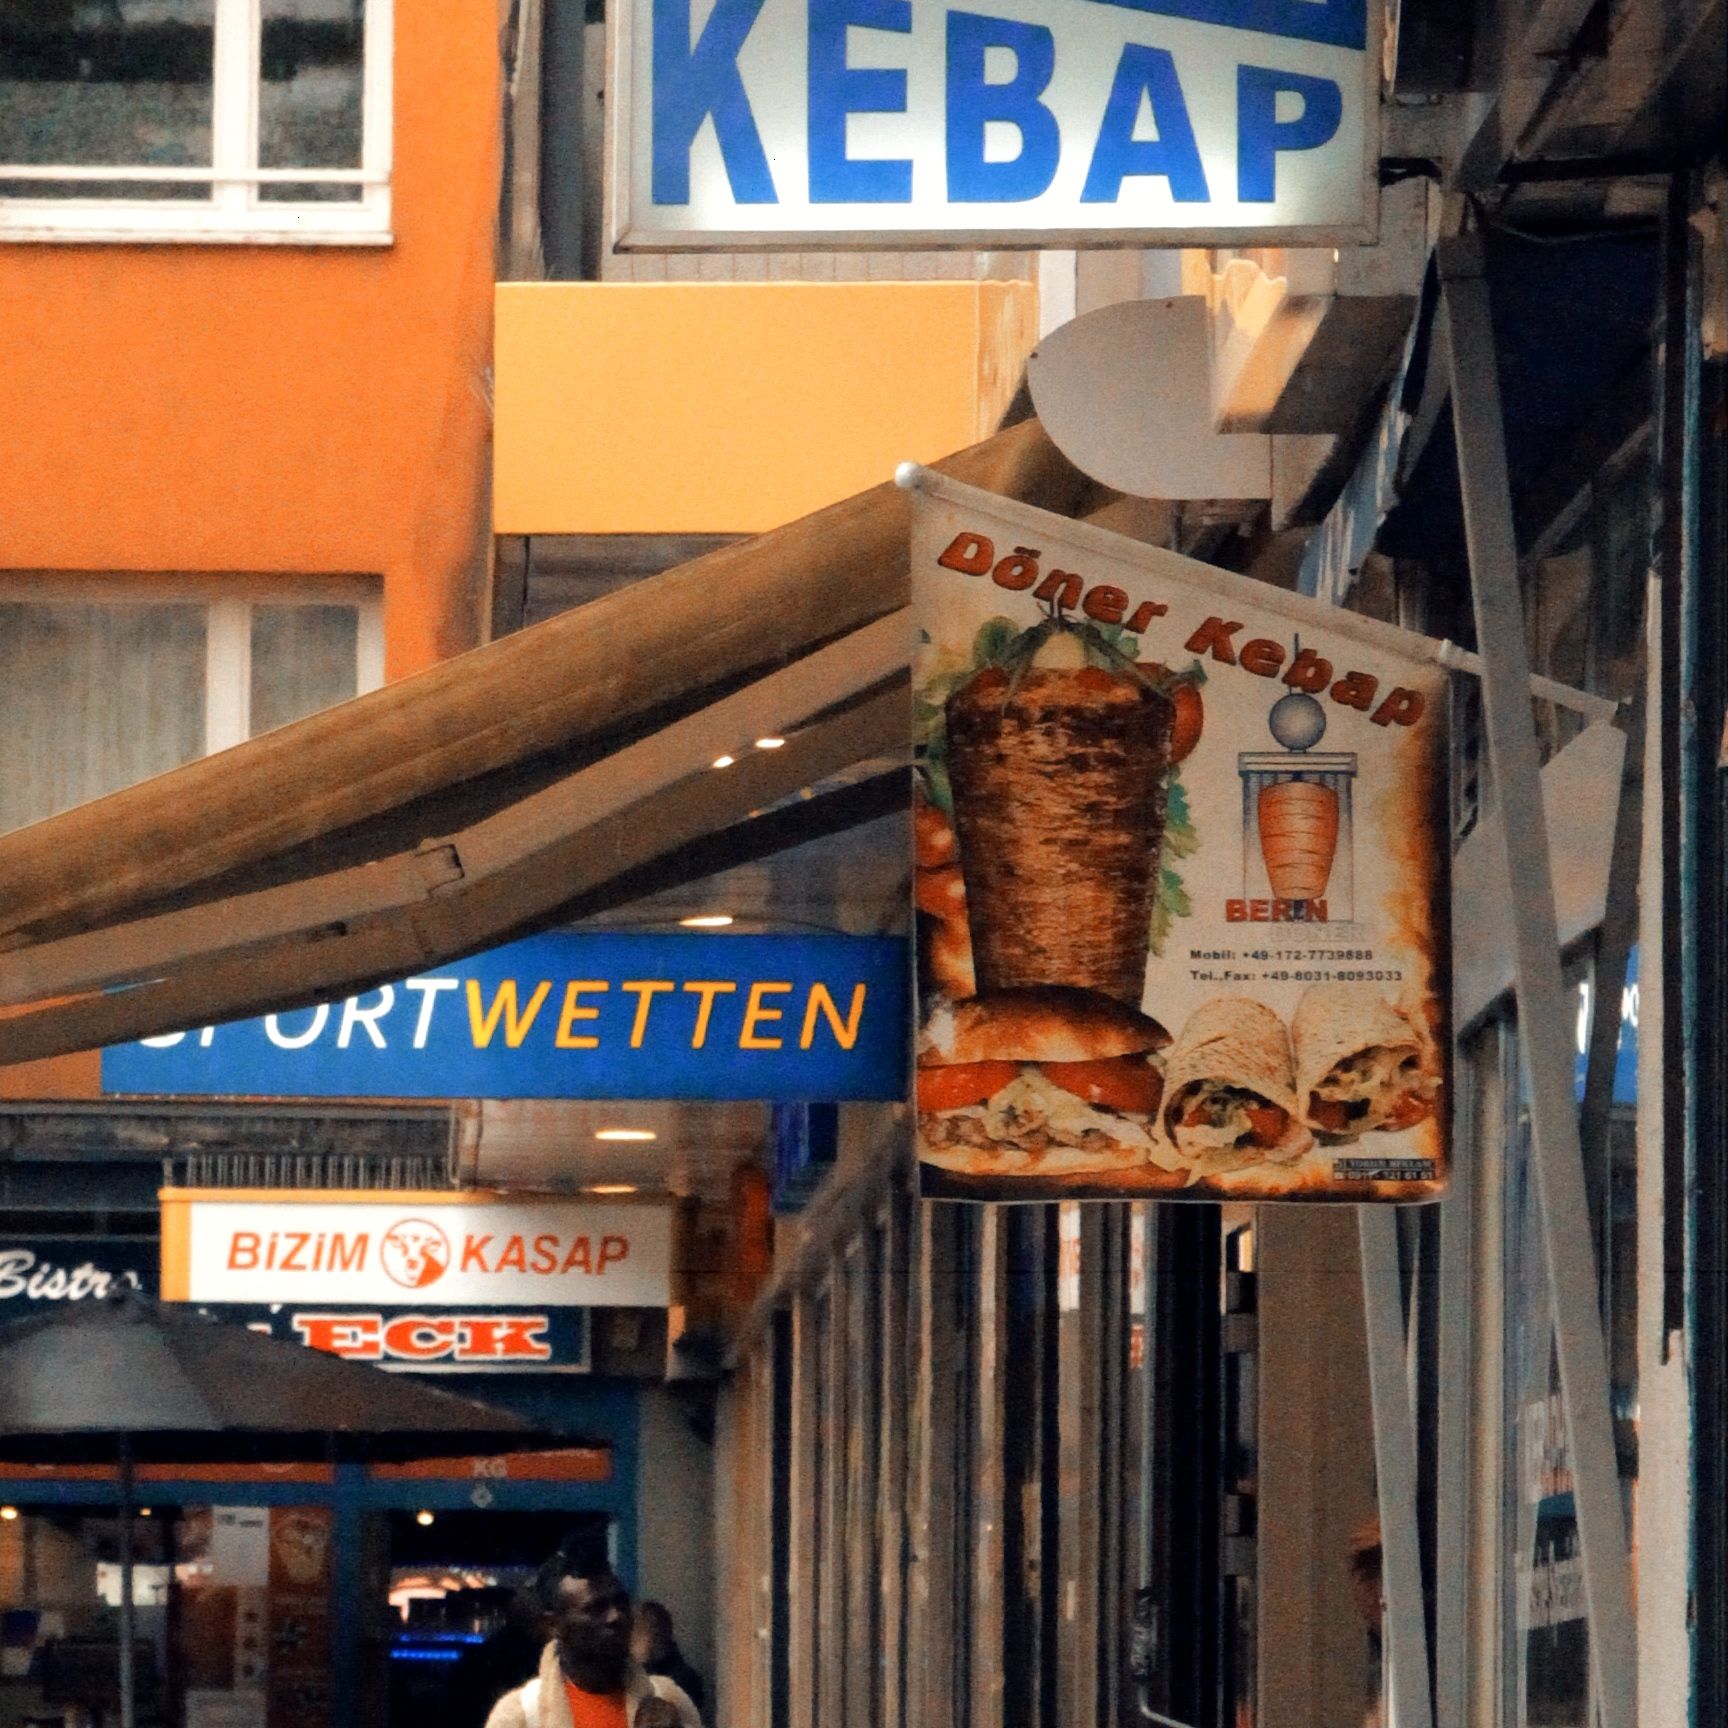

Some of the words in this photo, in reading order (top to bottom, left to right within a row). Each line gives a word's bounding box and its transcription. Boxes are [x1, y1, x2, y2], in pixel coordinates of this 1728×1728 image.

[937, 531, 1169, 634] Döner
[1184, 616, 1426, 728] Kebap
[1190, 949, 1236, 961] Mobil:
[136, 978, 867, 1050] ORTWETTEN
[459, 1234, 631, 1274] KASAP
